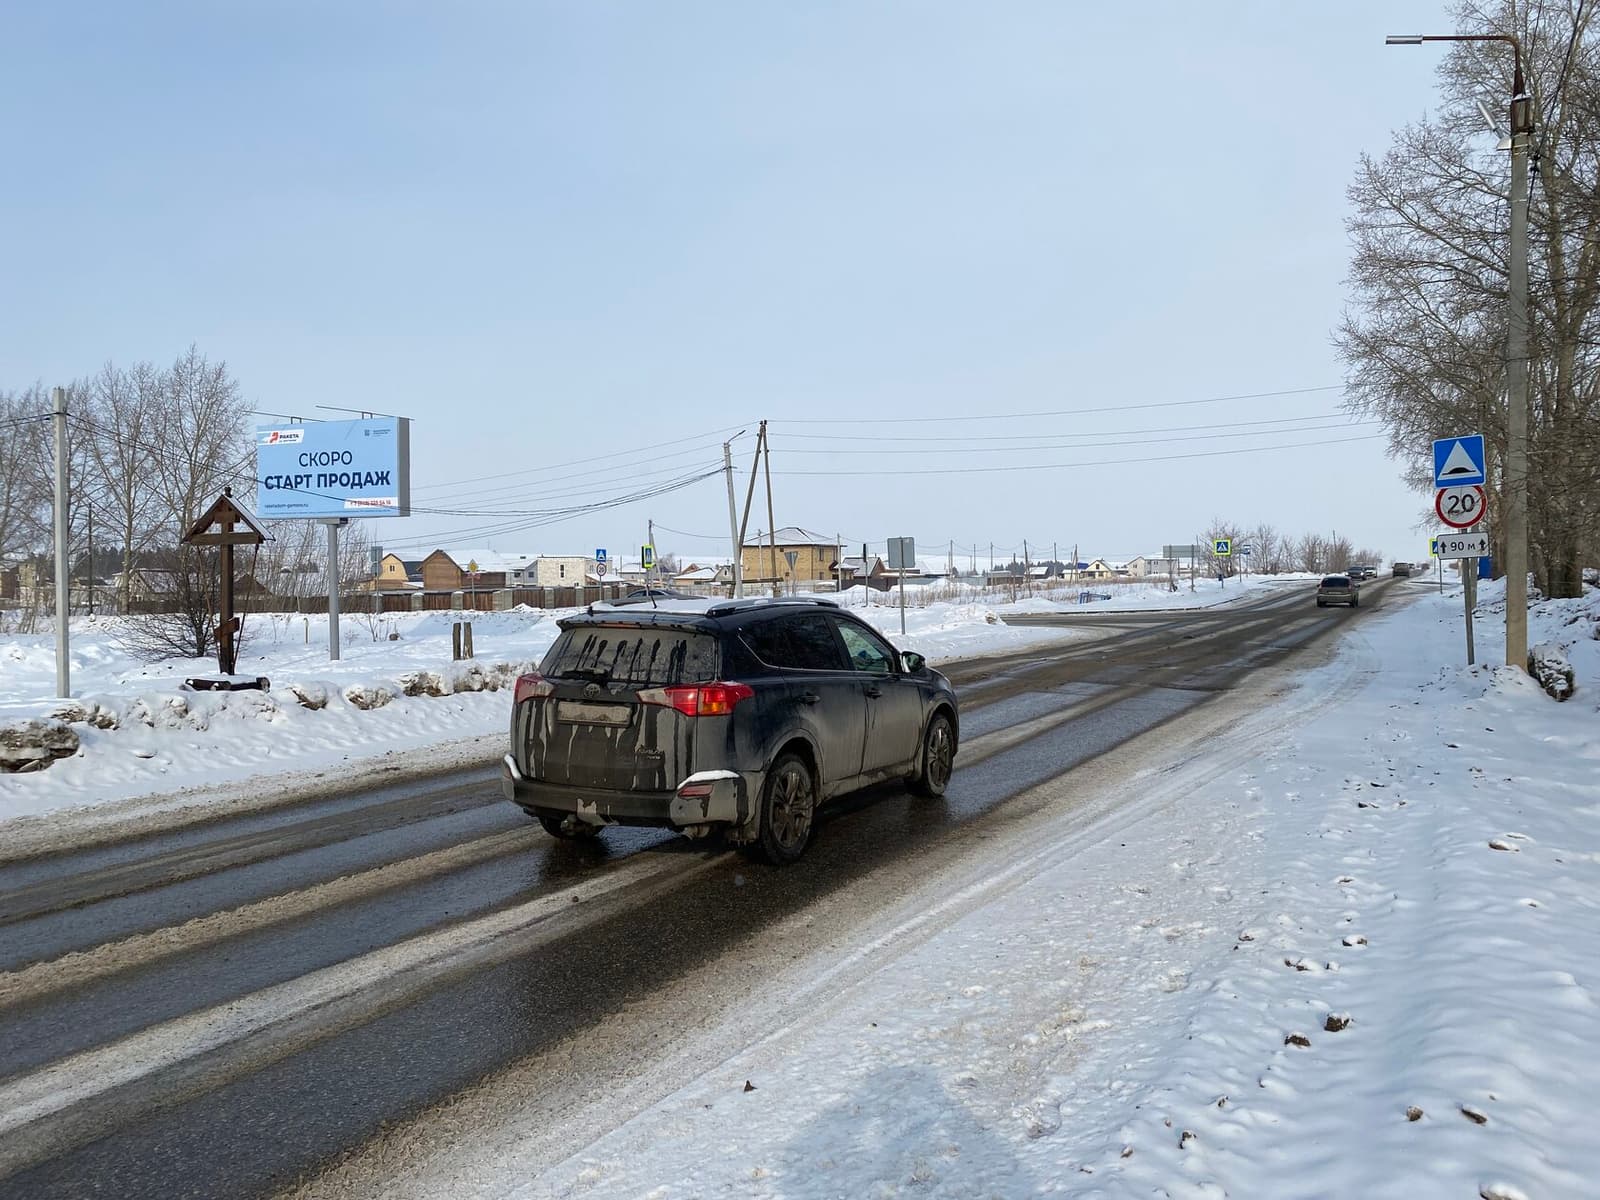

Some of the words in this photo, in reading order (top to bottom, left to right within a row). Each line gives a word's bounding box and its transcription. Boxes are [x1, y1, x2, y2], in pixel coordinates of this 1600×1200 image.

[298, 450, 353, 467] СКОРО
[264, 474, 312, 490] СТАРТ
[317, 470, 391, 489] ПРОДАЖ
[1447, 494, 1475, 514] 20
[1450, 541, 1465, 552] 90
